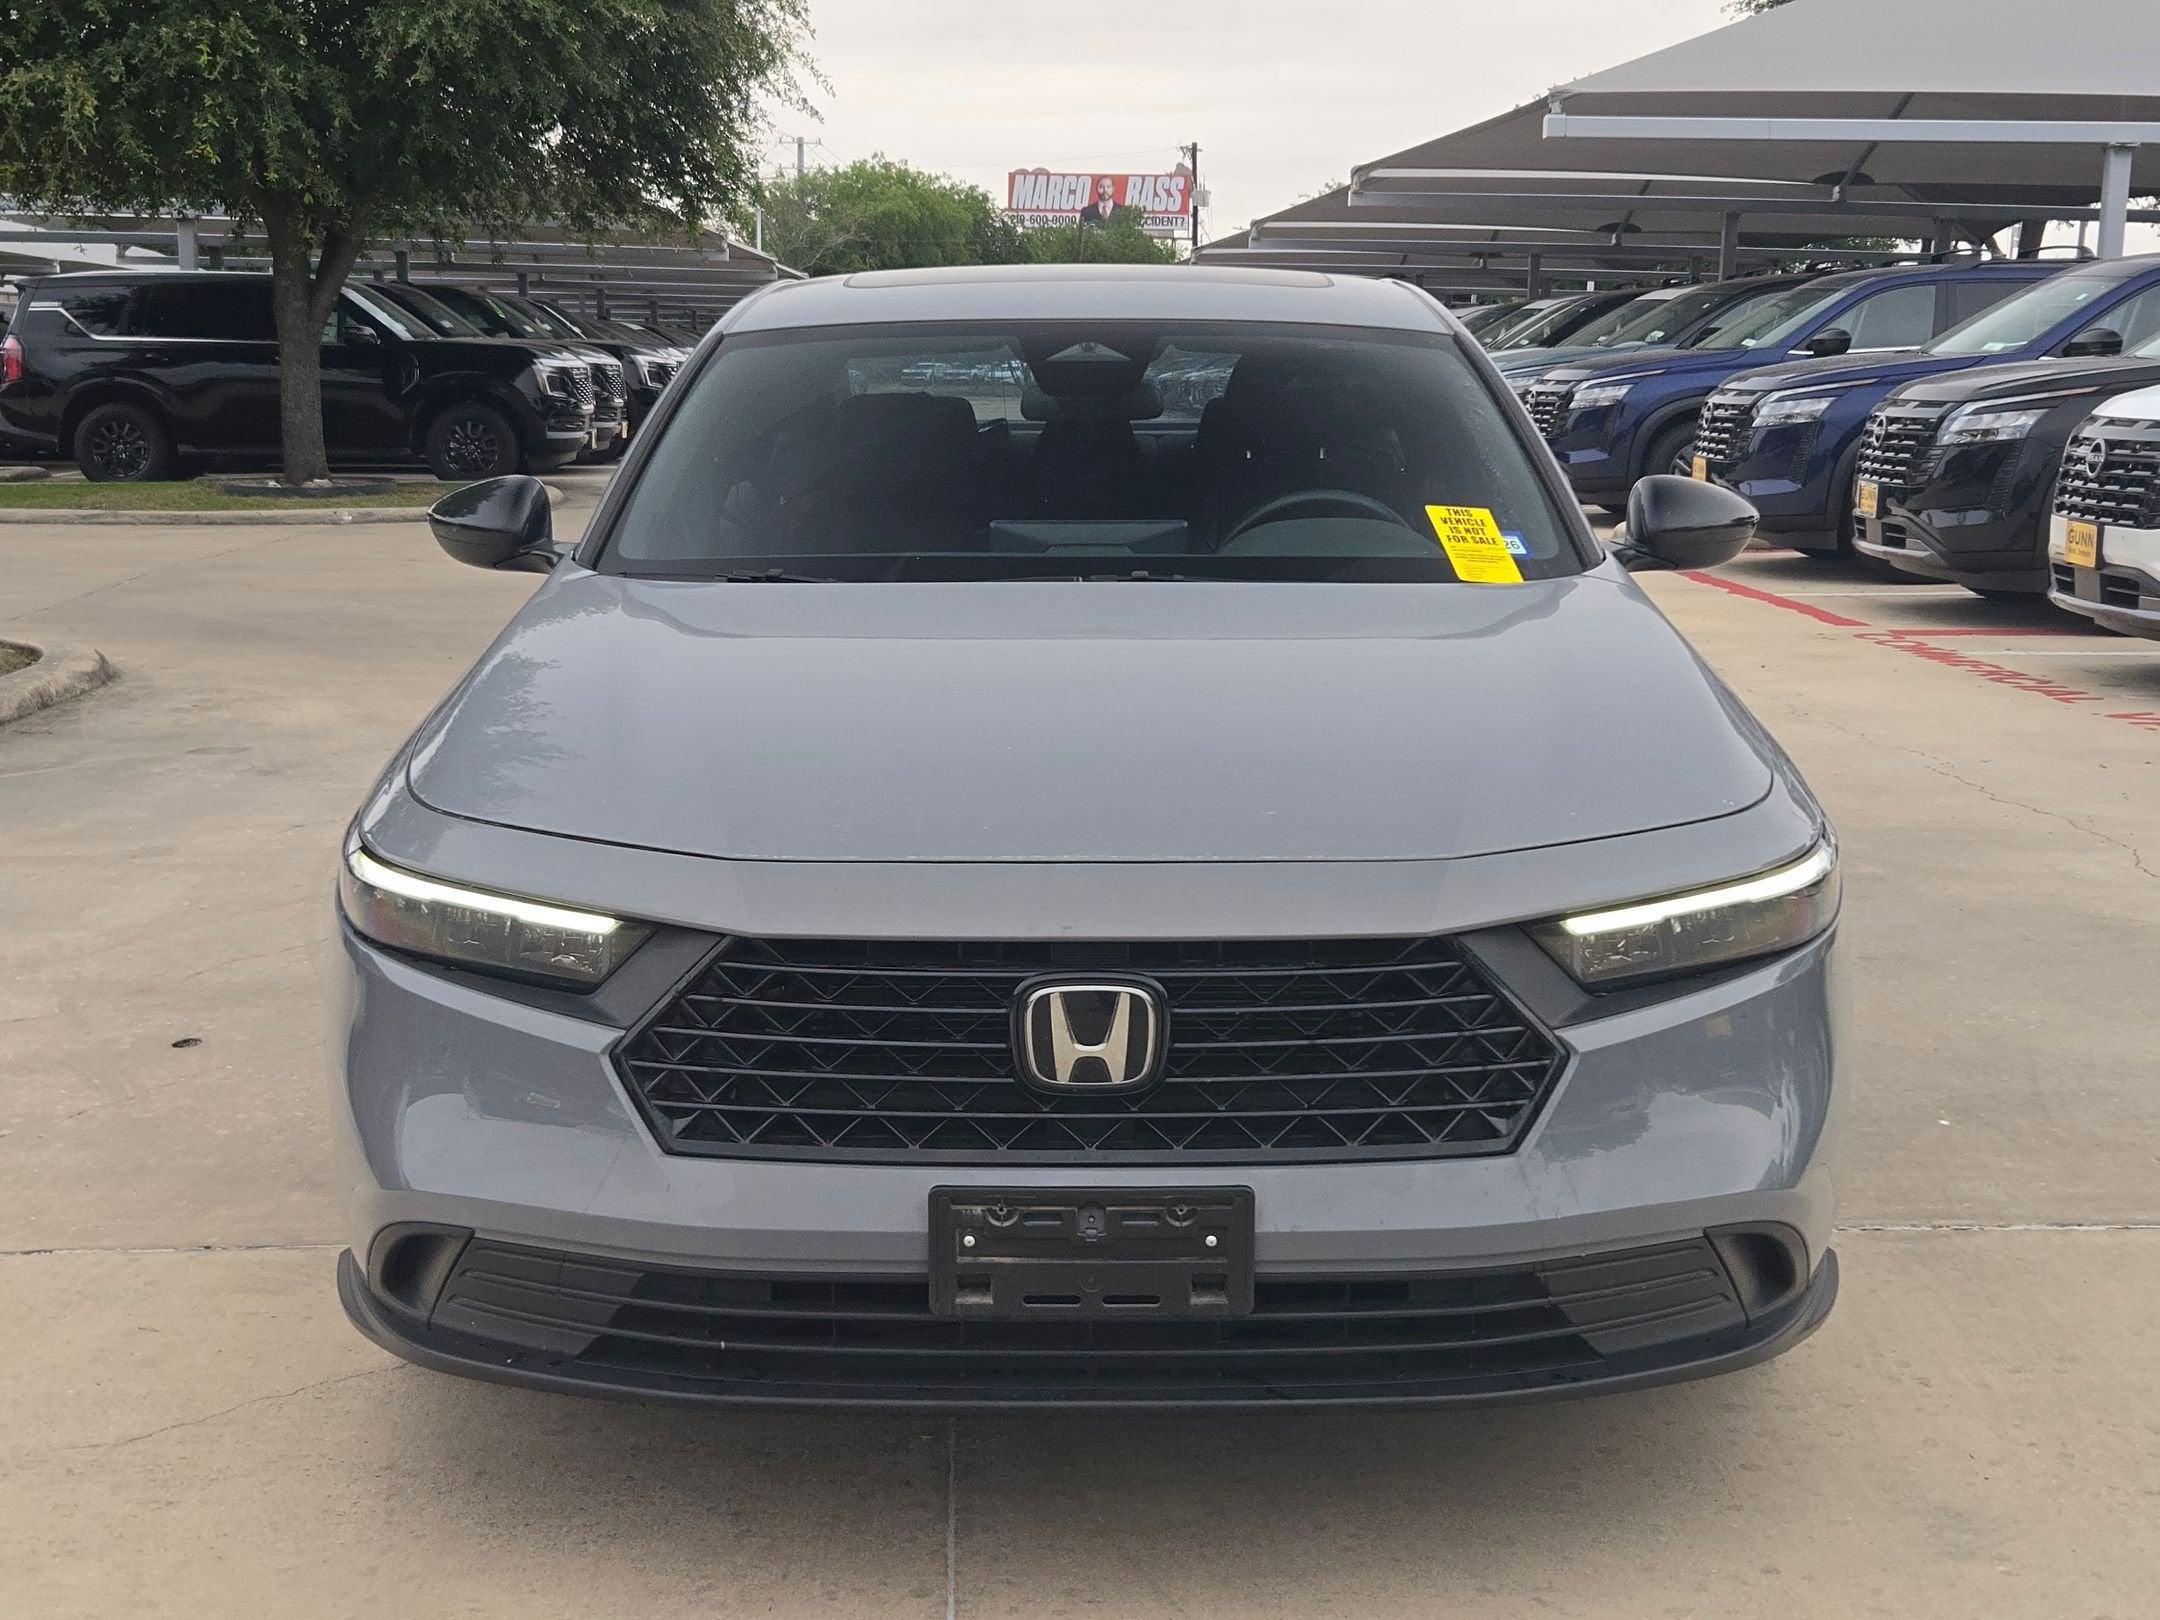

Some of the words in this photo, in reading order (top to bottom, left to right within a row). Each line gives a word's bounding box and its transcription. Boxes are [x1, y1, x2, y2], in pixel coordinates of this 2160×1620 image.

[1012, 175, 1091, 210] MARCO
[1445, 508, 1473, 517] THIS
[1440, 517, 1487, 527] VEHICLE
[1449, 526, 1462, 534] IS
[1463, 527, 1486, 536] NOT
[1446, 535, 1469, 543] FOR
[1470, 536, 1498, 545] SALE
[2068, 529, 2094, 549] GUNN
